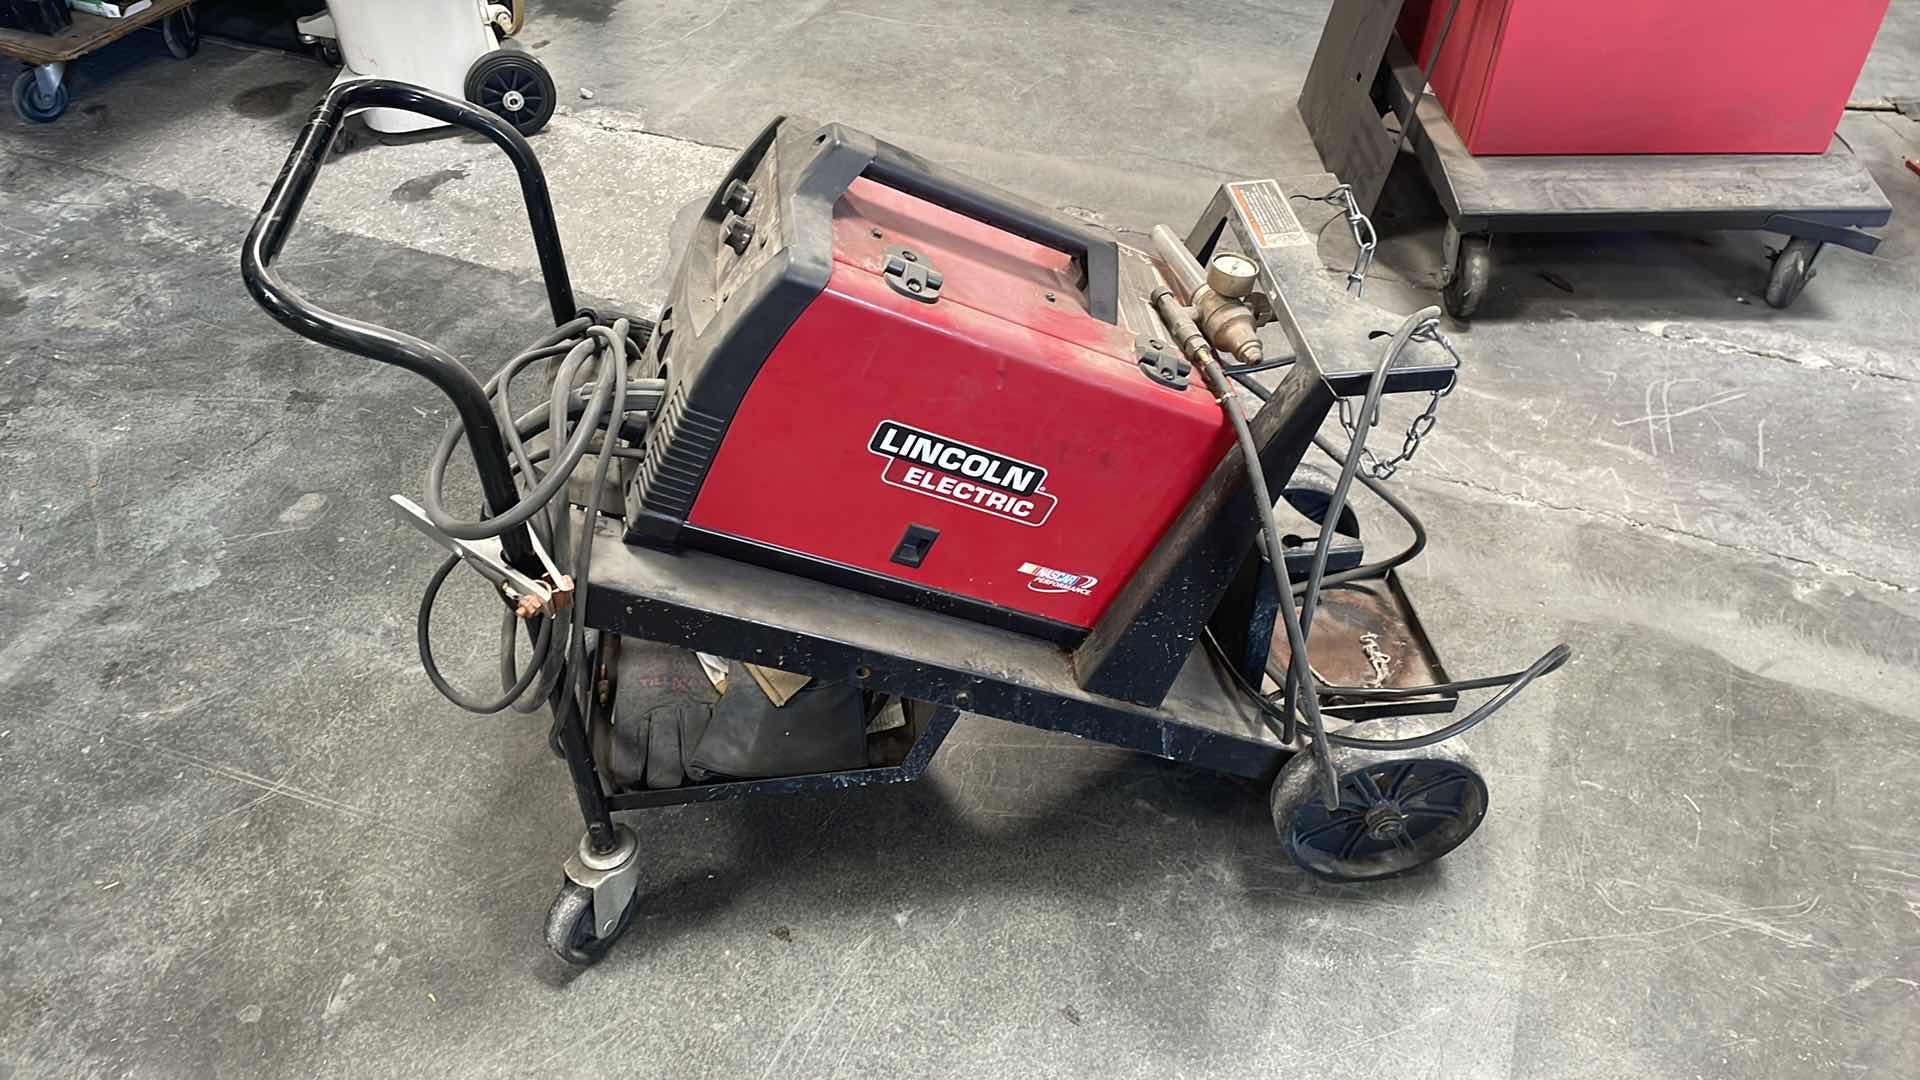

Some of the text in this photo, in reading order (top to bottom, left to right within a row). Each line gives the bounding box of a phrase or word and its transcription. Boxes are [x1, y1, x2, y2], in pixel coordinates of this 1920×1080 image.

[879, 428, 1036, 492] LINCOLN
[902, 467, 1035, 518] ELECTRIC
[1034, 577, 1092, 596] PERFORMANCE
[1038, 567, 1077, 585] NASCAR
